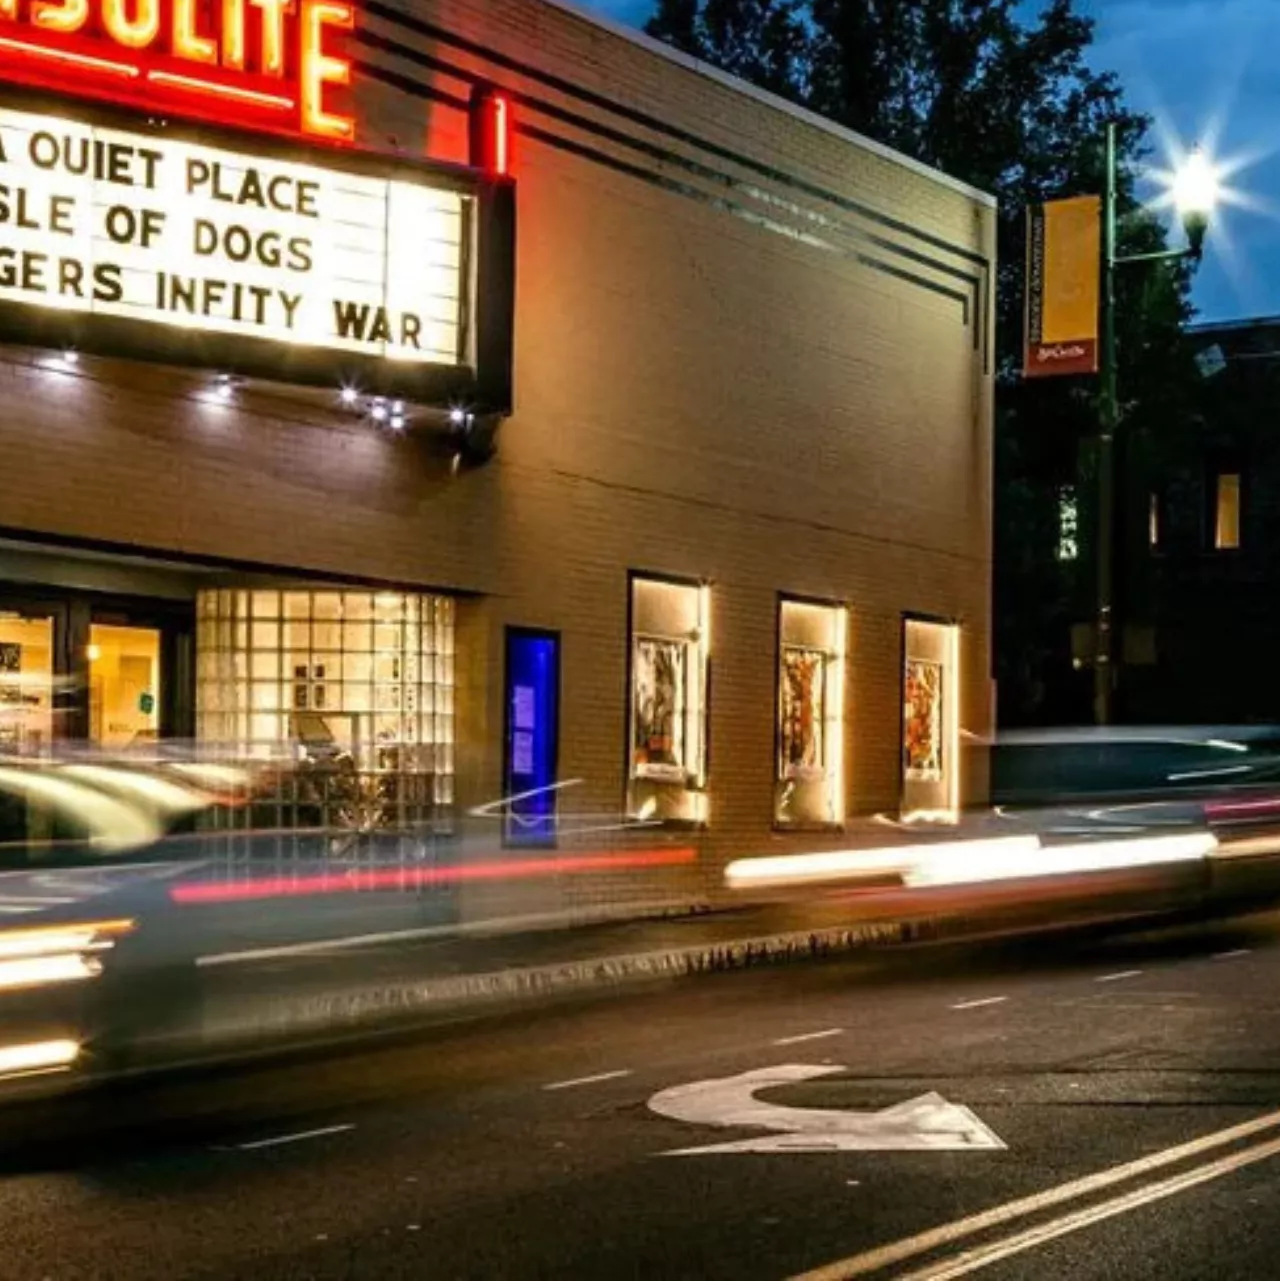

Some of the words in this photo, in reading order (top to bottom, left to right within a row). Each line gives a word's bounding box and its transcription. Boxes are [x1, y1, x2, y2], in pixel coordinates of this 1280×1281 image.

[185, 156, 320, 218] PLACE
[104, 203, 167, 249] OF
[194, 218, 313, 273] DOGS
[155, 269, 302, 329] INFITY
[332, 299, 422, 350] WAR
